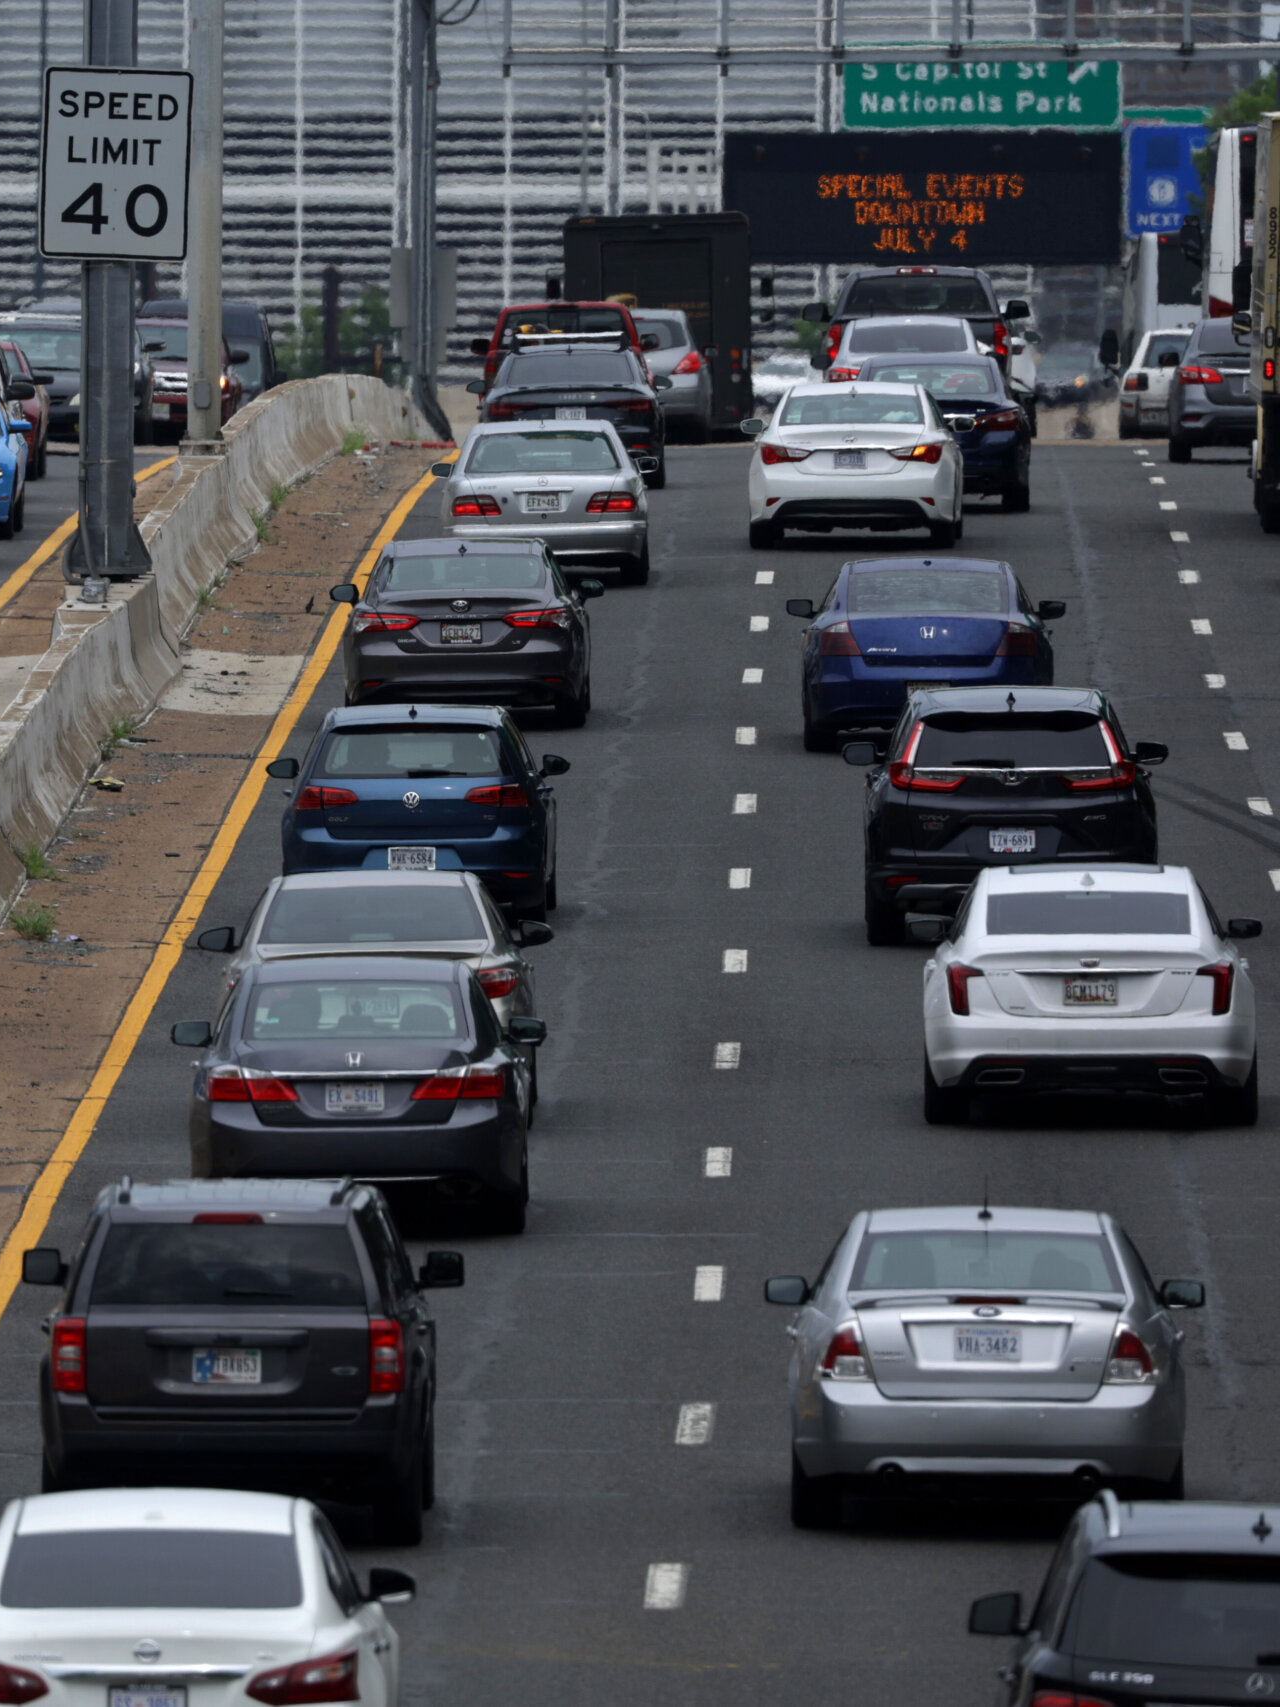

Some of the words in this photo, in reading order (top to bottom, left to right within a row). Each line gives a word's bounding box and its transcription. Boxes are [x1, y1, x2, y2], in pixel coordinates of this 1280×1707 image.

[861, 62, 878, 80] S
[895, 62, 1001, 84] Captol
[1017, 62, 1047, 80] St
[58, 89, 179, 121] SPEED
[861, 91, 1002, 114] Nationals
[1016, 91, 1082, 114] Park
[67, 135, 162, 166] LIMIT
[817, 173, 913, 200] SPECIAL
[926, 173, 1024, 200] EVENTS
[61, 182, 168, 238] 40
[854, 200, 986, 226] DOWNTOWN
[1136, 213, 1181, 227] NEXT
[872, 226, 936, 253] JULY
[950, 229, 967, 253] 4
